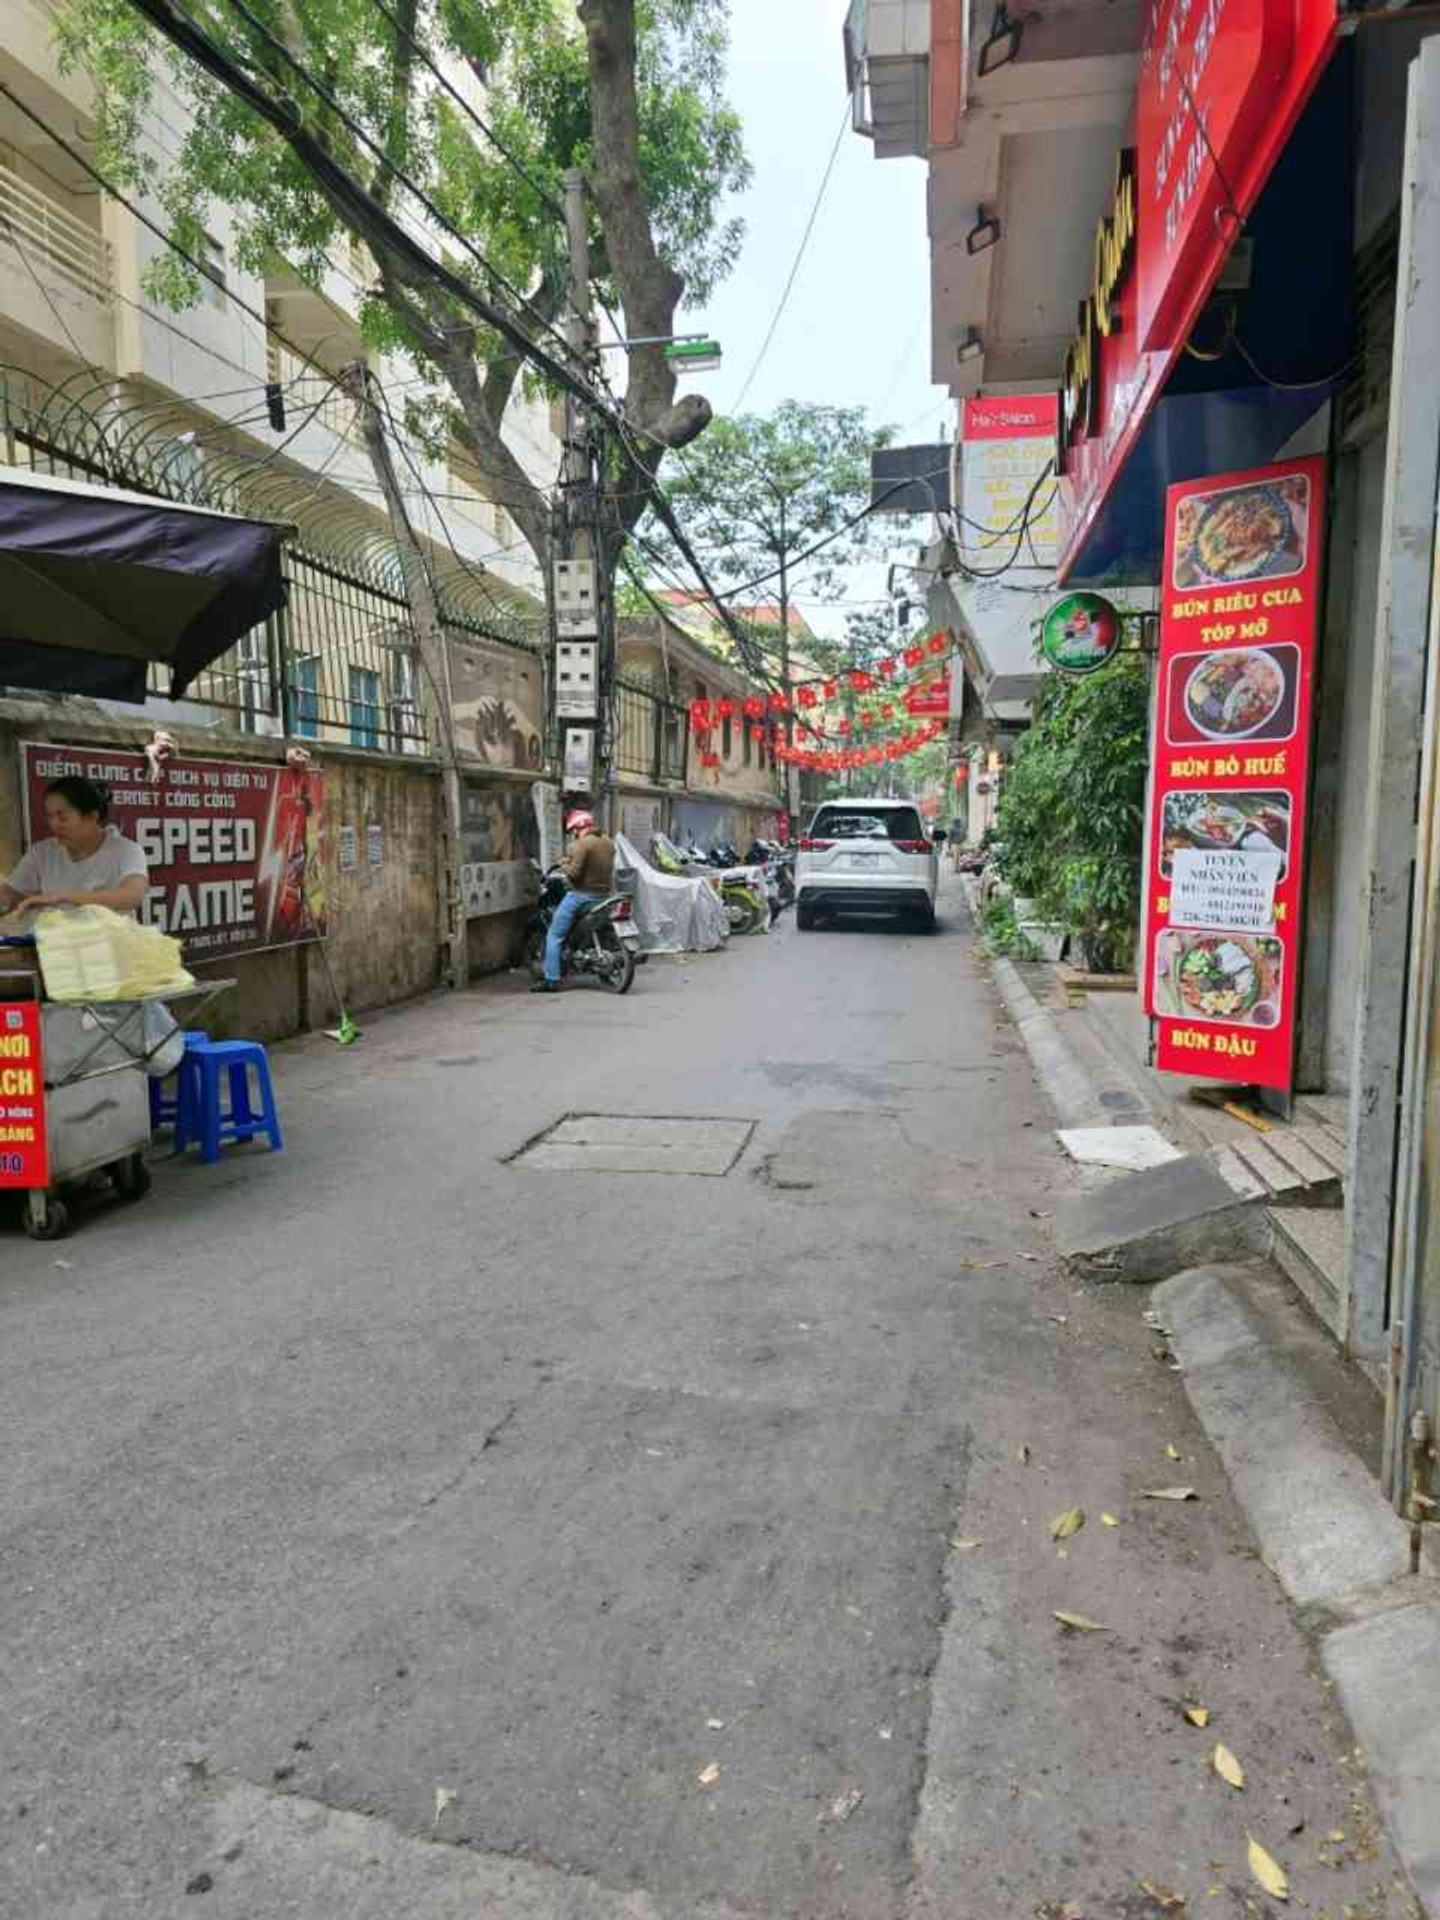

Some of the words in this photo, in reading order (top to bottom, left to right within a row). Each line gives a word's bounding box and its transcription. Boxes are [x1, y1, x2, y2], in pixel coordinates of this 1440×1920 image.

[1172, 598, 1209, 619] BÚN
[1262, 588, 1303, 607] CUA
[87, 763, 130, 781] CUNG
[1170, 756, 1209, 777] BÚN
[1214, 754, 1239, 776] BÒ
[1244, 750, 1287, 776] HUẾ
[136, 817, 256, 865] SPEED
[142, 879, 256, 932] GAME
[1172, 1027, 1210, 1050] BÚN
[1214, 1032, 1256, 1057] ĐẬU
